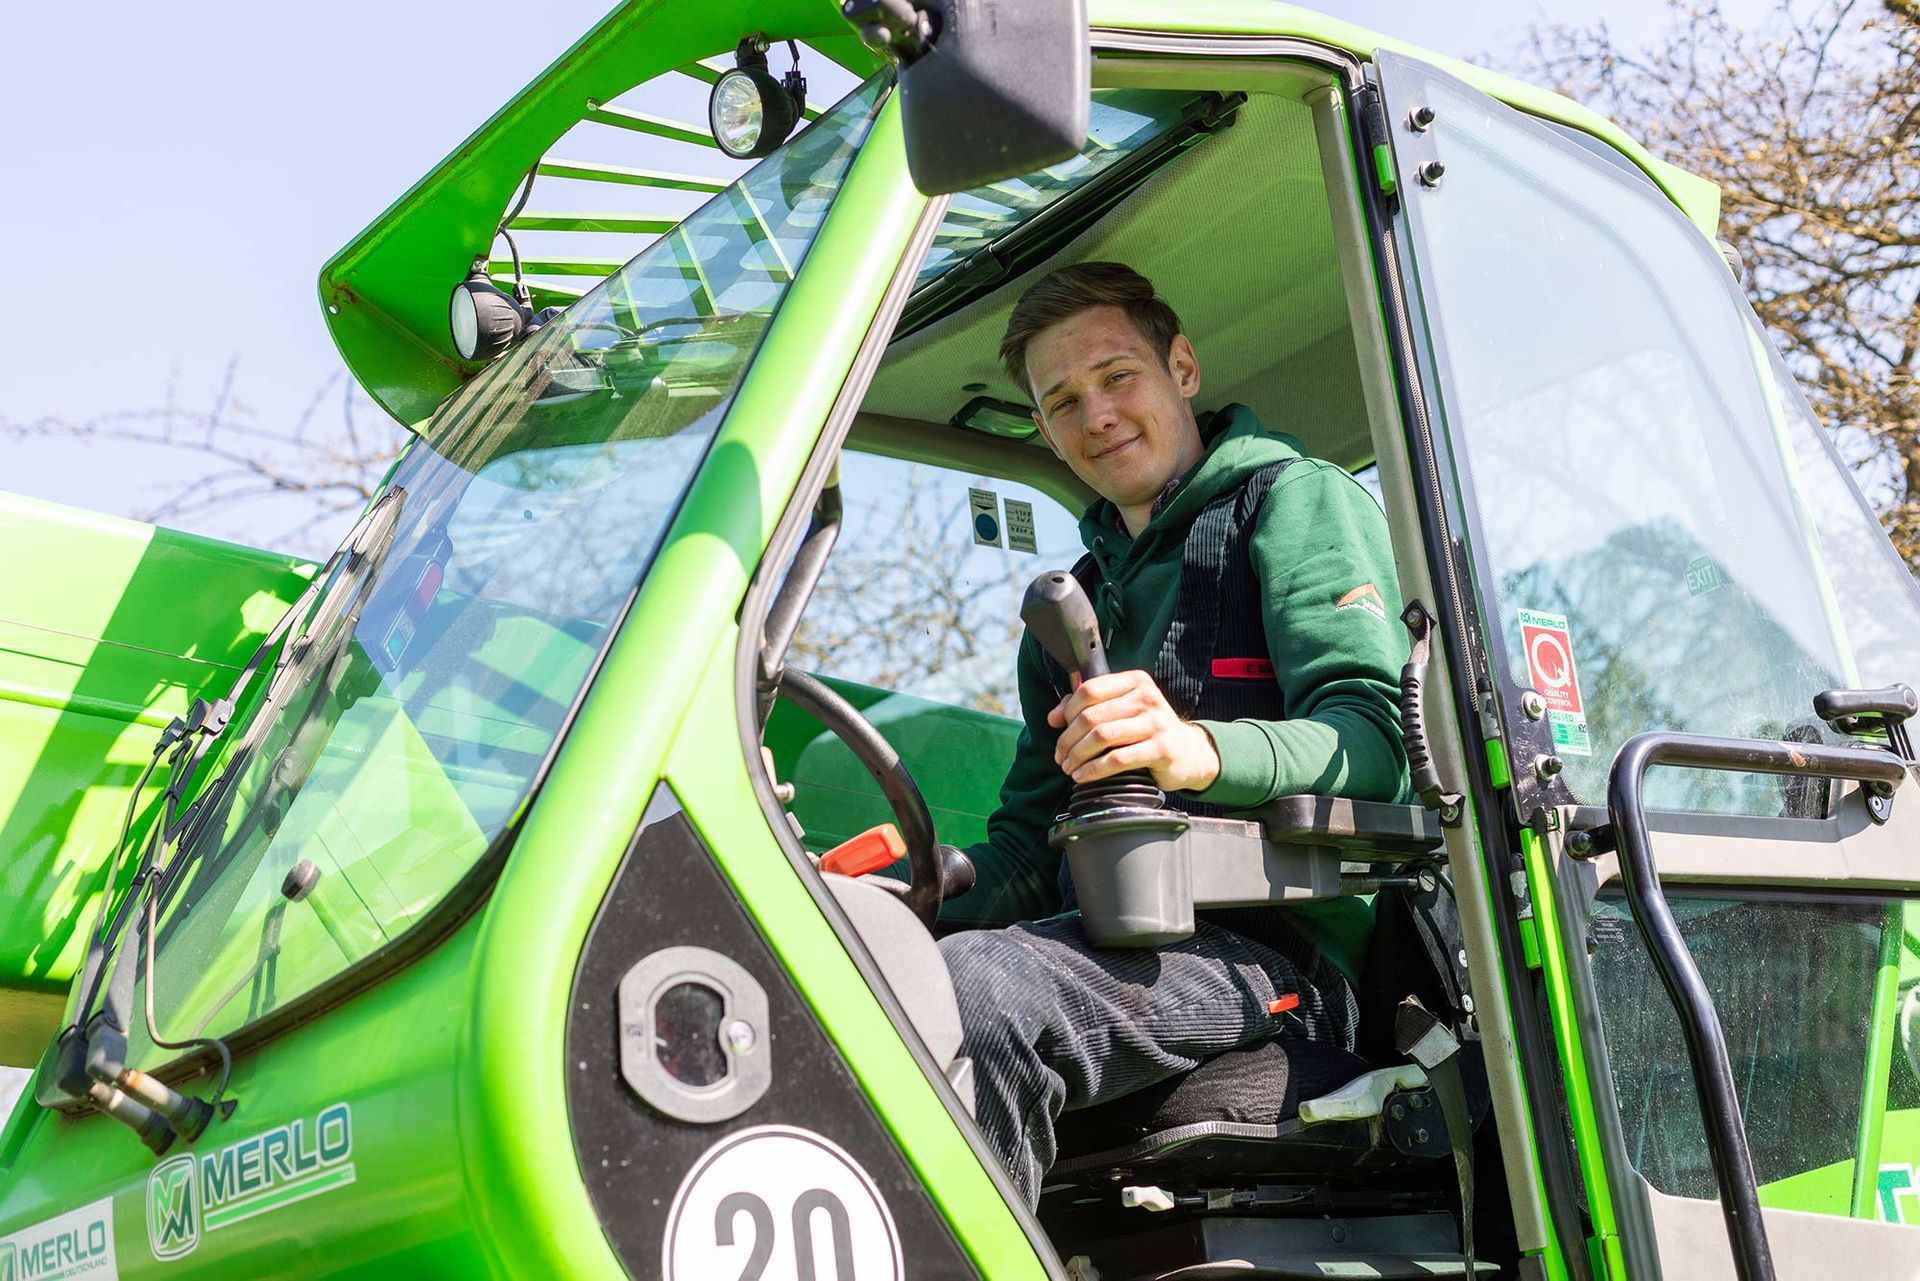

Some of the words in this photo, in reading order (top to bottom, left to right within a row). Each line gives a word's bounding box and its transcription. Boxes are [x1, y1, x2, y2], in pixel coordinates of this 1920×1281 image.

[1686, 565, 1713, 591] EXIT
[1531, 616, 1567, 629] MERLO
[1544, 688, 1570, 699] QUALITY
[202, 1105, 350, 1208] MERLO
[20, 1220, 106, 1281] MERLO
[714, 1188, 857, 1281] 20
